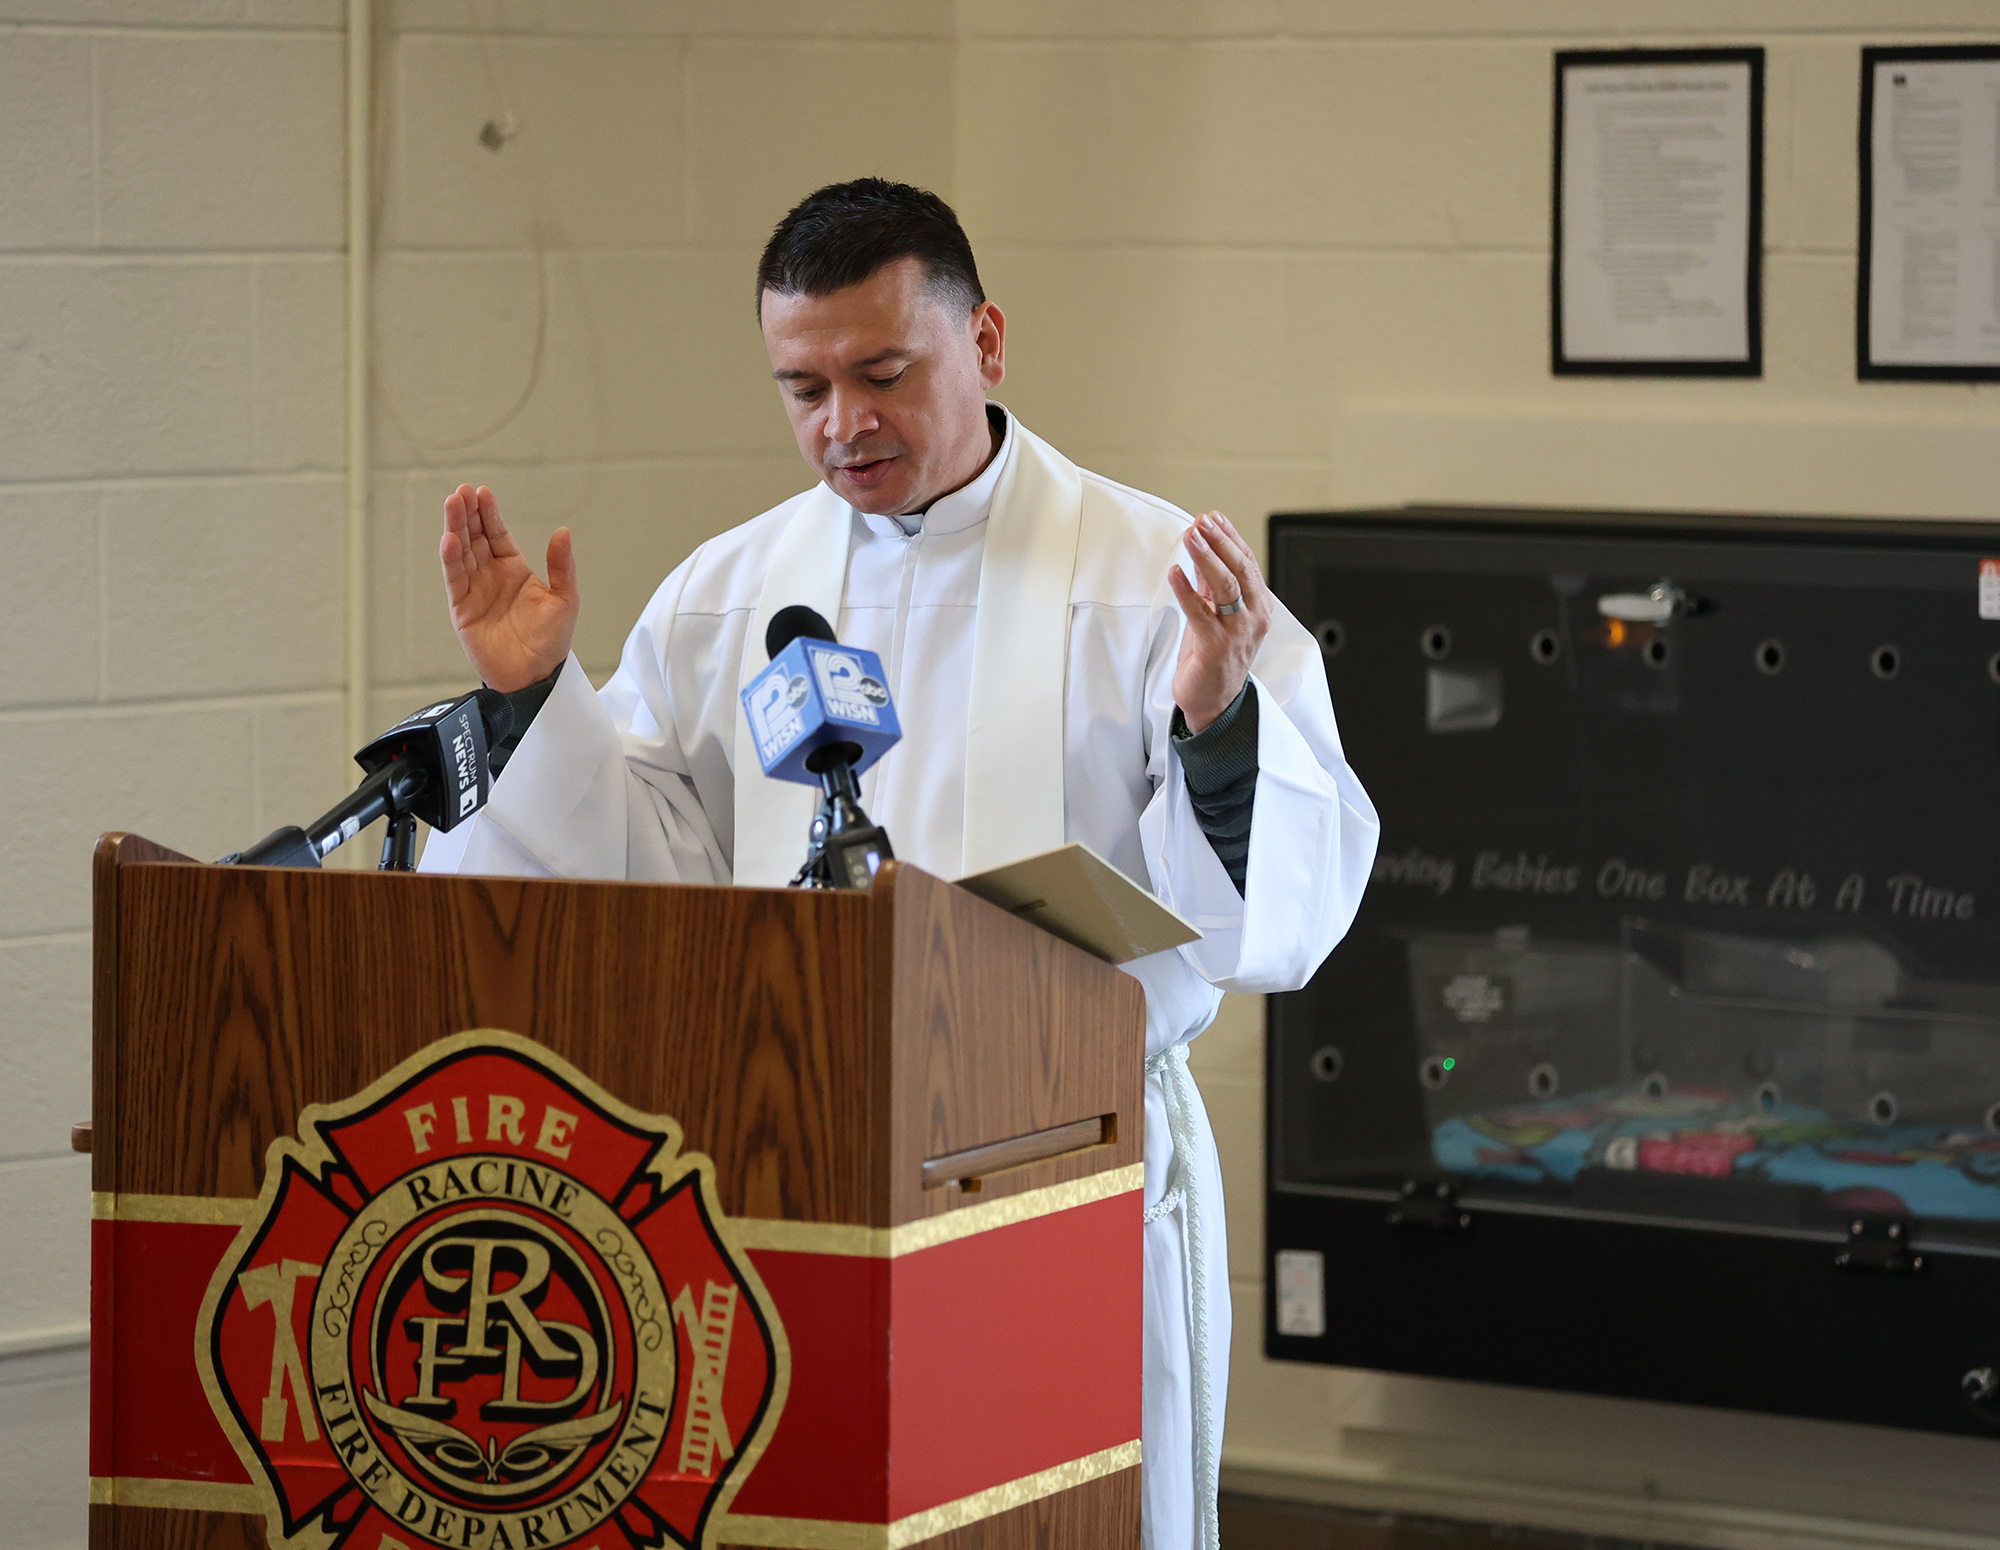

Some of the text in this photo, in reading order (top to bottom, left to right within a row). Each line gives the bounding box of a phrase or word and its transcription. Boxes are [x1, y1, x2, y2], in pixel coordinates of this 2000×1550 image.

[750, 673, 800, 746] 12
[814, 651, 872, 707] 12
[762, 715, 802, 760] WISN
[826, 699, 877, 722] WISN
[453, 734, 470, 790] NEWS
[459, 713, 477, 783] SPECTRUM
[1372, 849, 1976, 921] aving Babies One Box At A Time
[403, 1094, 579, 1161] FIRE
[405, 1160, 580, 1218] RACINE
[317, 1379, 668, 1550] FIRE DEPARTMENT
